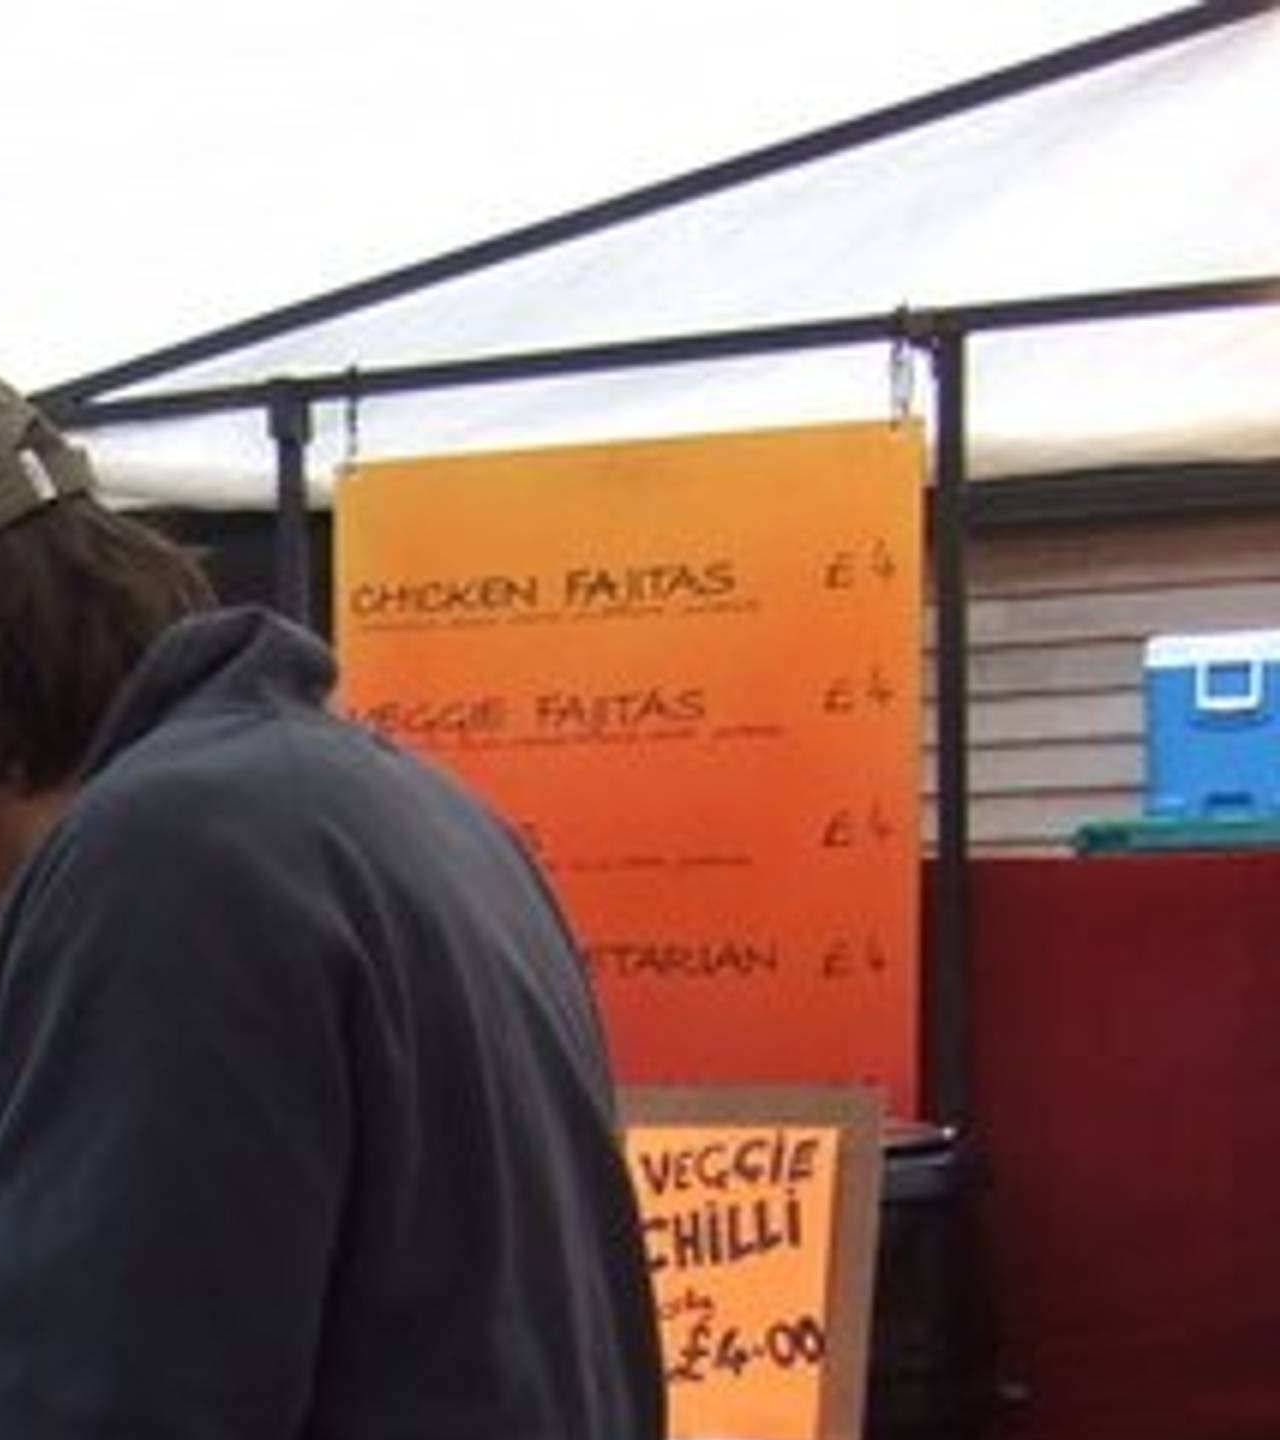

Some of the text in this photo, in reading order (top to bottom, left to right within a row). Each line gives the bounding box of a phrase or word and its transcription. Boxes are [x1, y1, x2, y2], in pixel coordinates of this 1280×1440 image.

[348, 574, 539, 619] CHICKEN
[564, 561, 737, 607] FAJITAS
[536, 689, 707, 732] FAJITAS
[586, 936, 778, 980] TARIAN
[638, 1129, 820, 1197] VEGGIE
